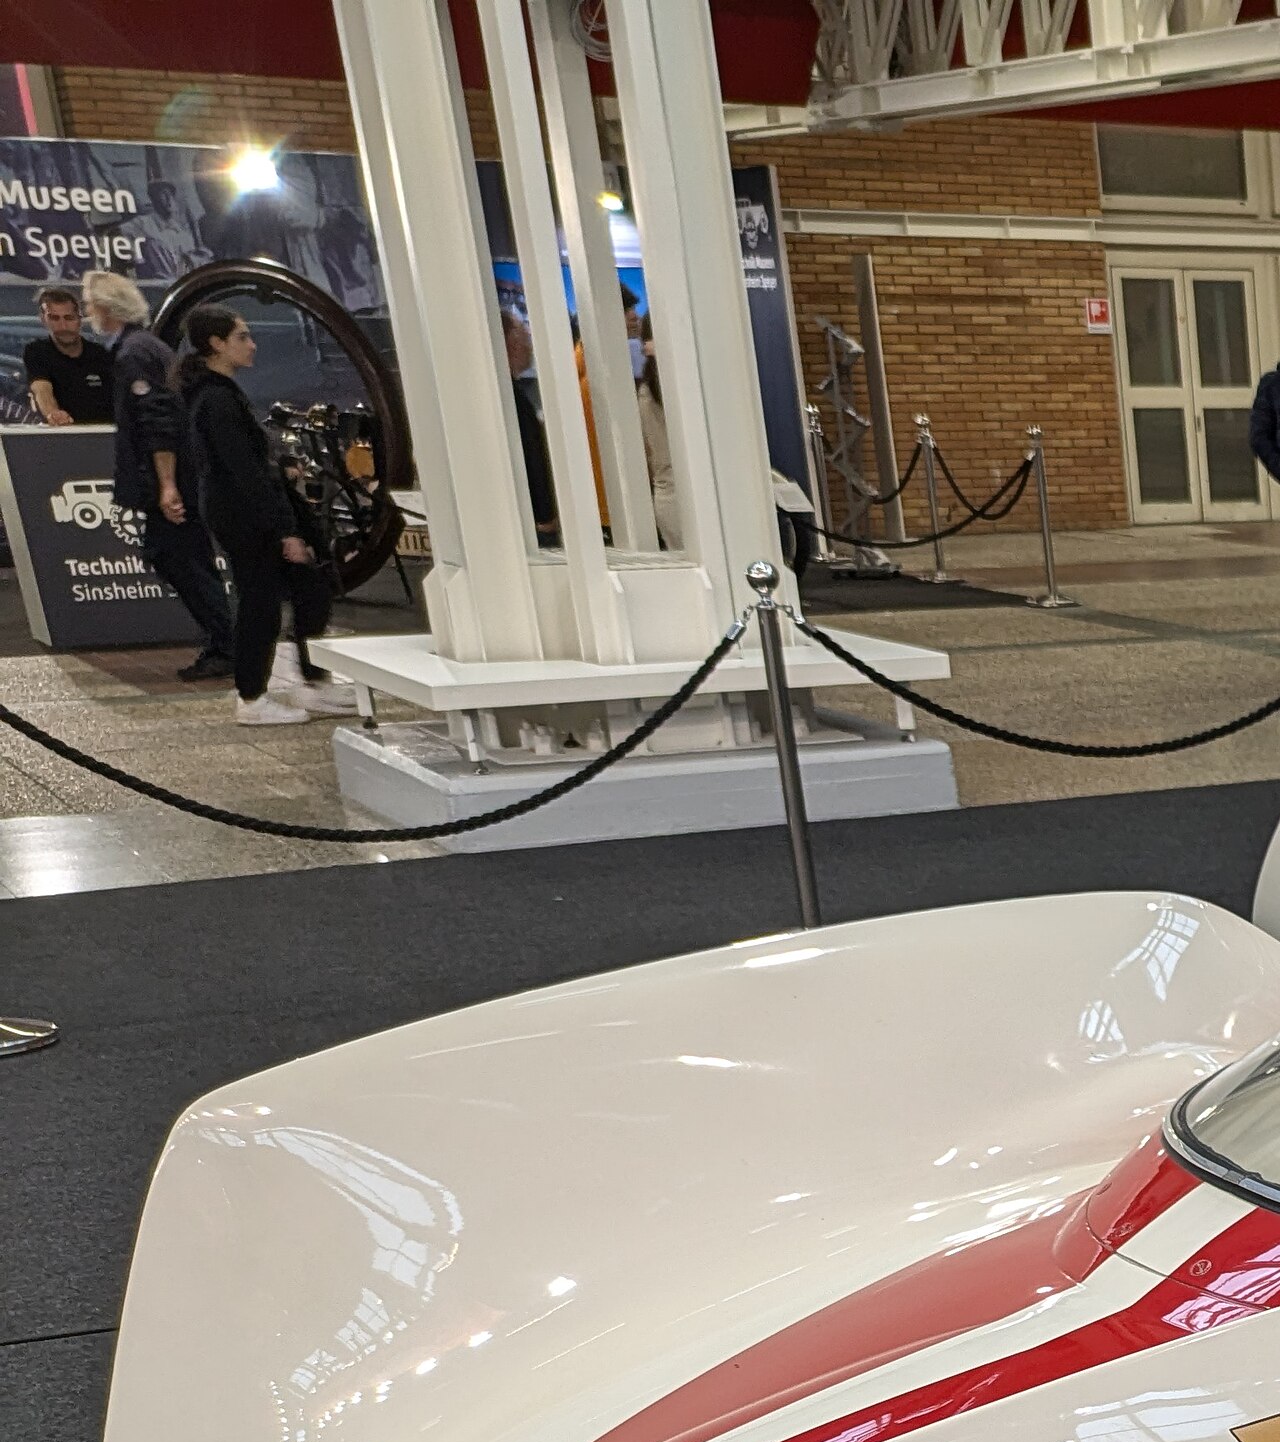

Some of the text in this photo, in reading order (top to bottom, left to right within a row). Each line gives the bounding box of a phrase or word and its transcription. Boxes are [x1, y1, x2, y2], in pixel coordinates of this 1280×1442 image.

[0, 179, 137, 214] Museen
[25, 226, 146, 269] Speyer
[64, 555, 146, 577] Technik
[72, 580, 163, 602] Sinsheim
